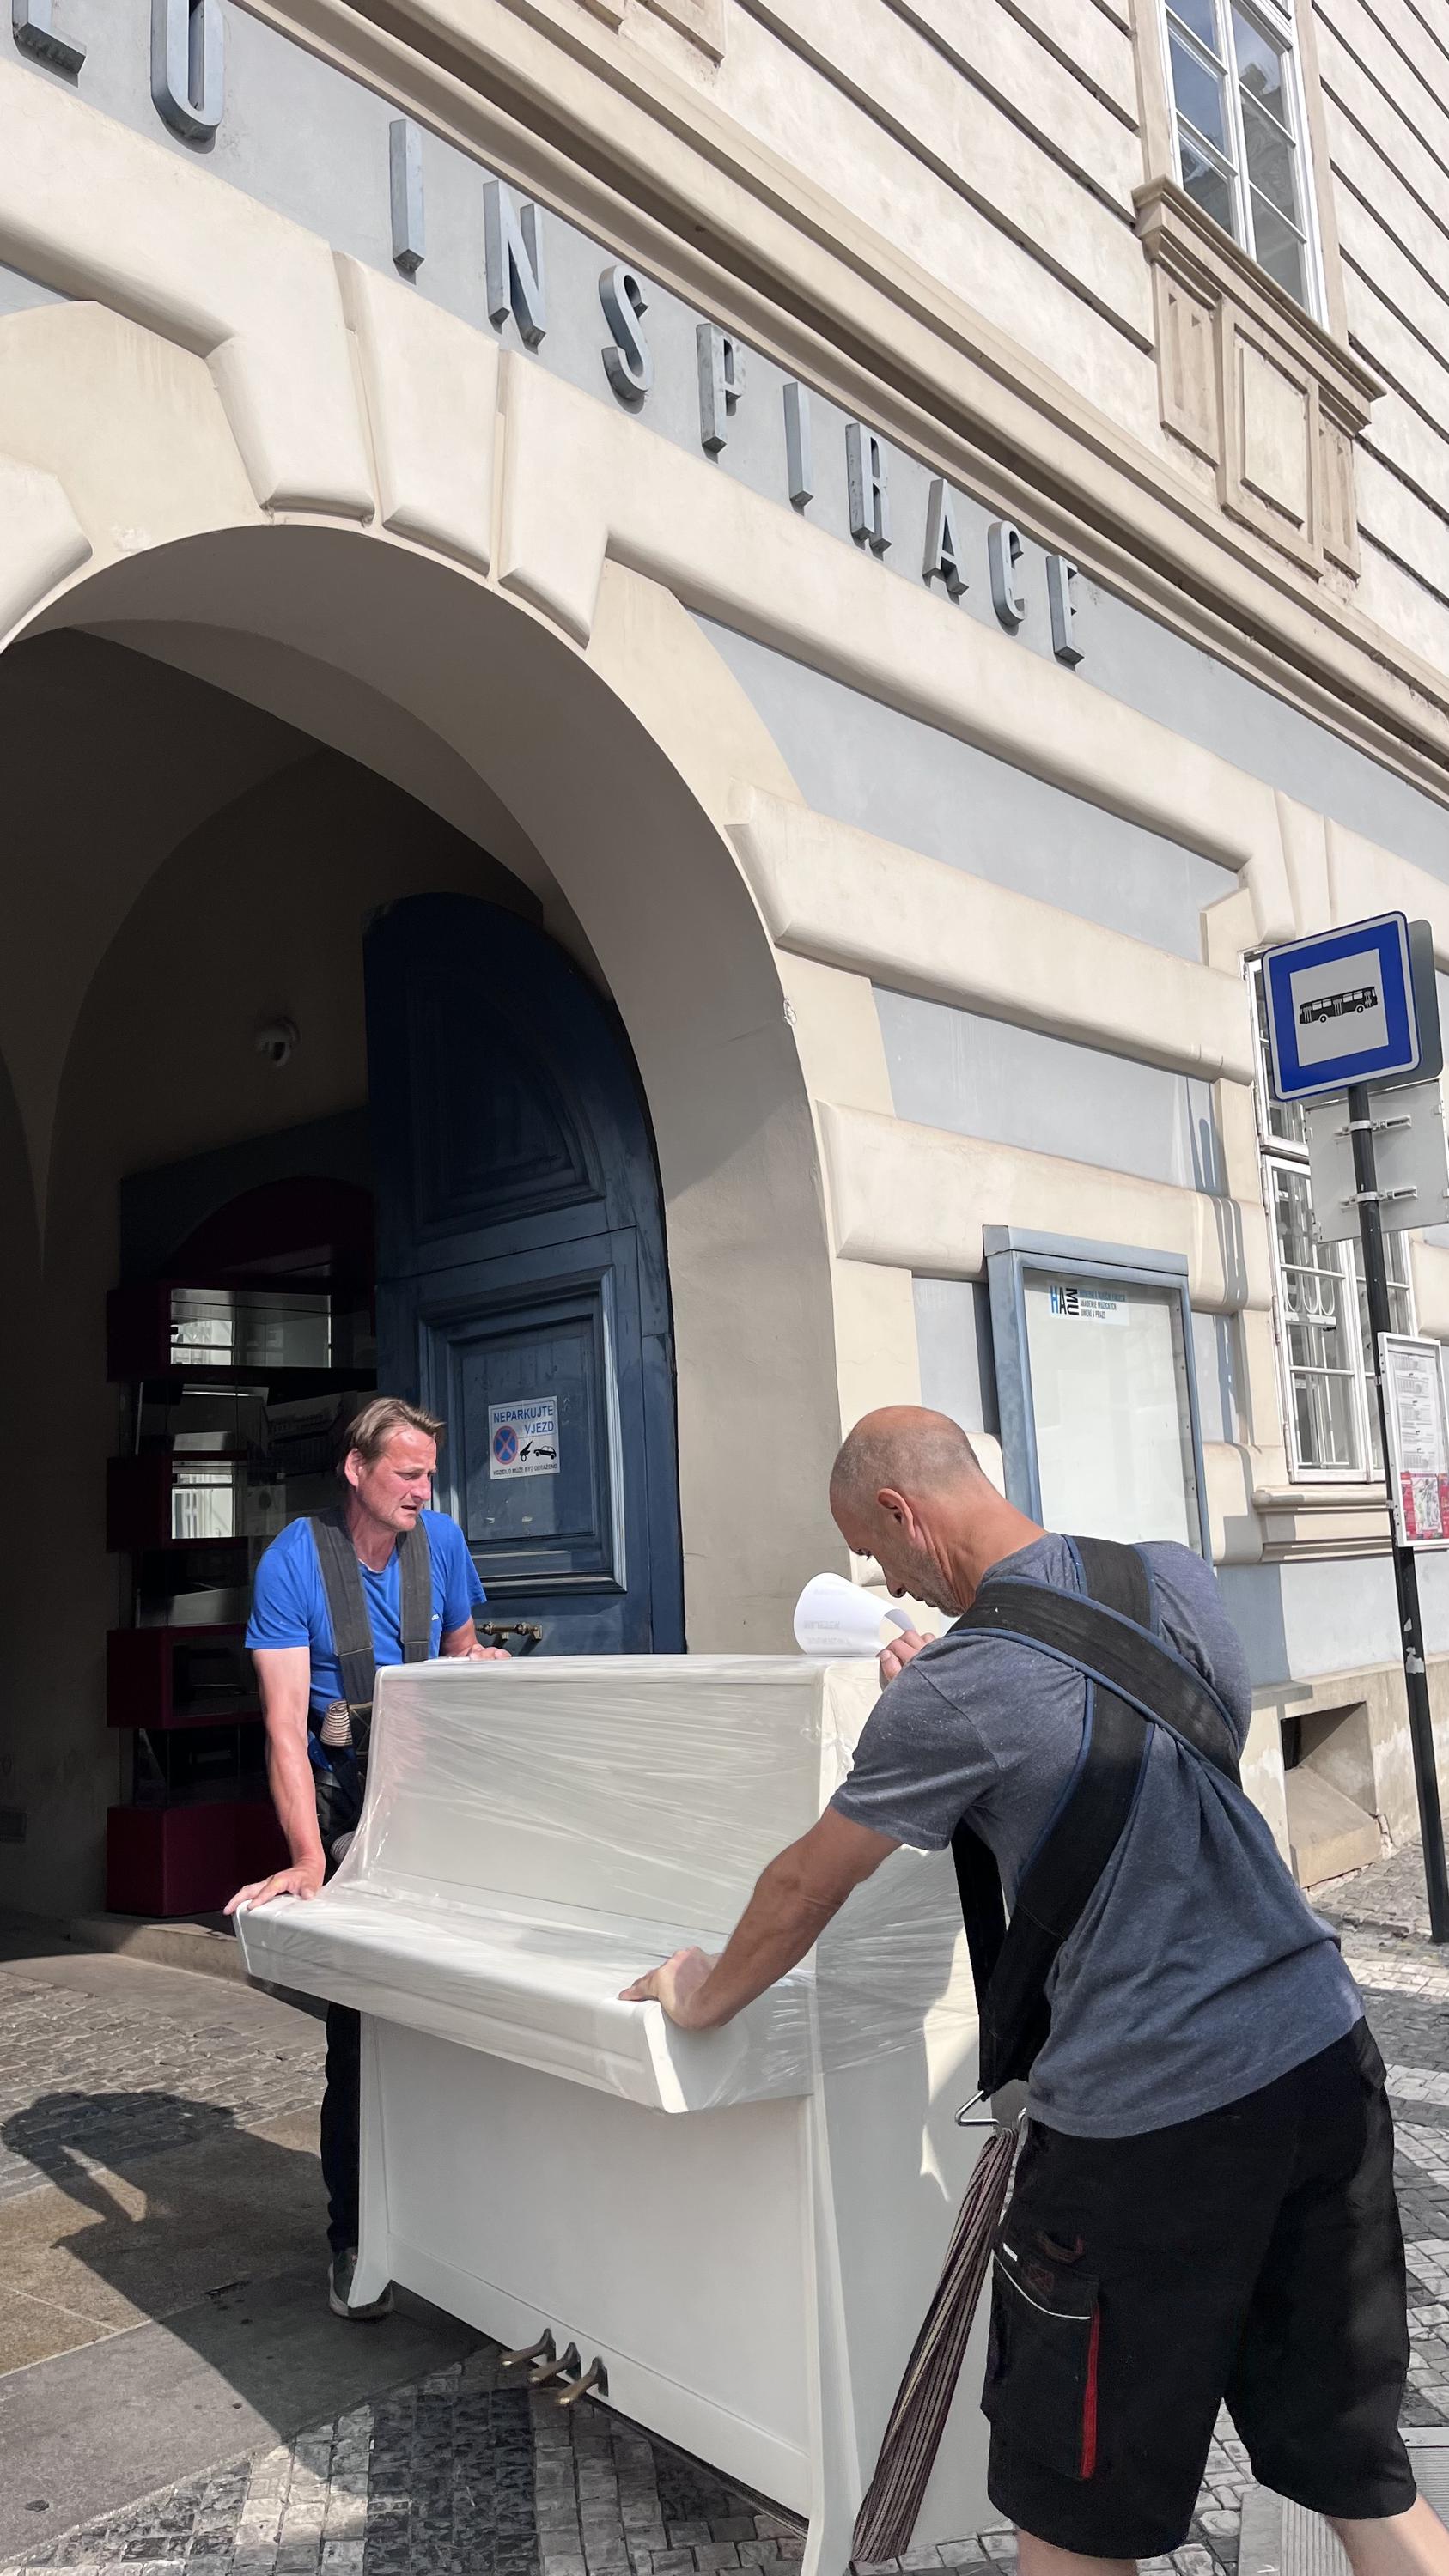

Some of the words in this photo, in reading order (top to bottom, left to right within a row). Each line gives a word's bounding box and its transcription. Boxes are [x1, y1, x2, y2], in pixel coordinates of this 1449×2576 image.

[389, 118, 1085, 666] INSPIRACE
[494, 1406, 553, 1422] NEPARKUJTE
[524, 1421, 554, 1434] VJEZD
